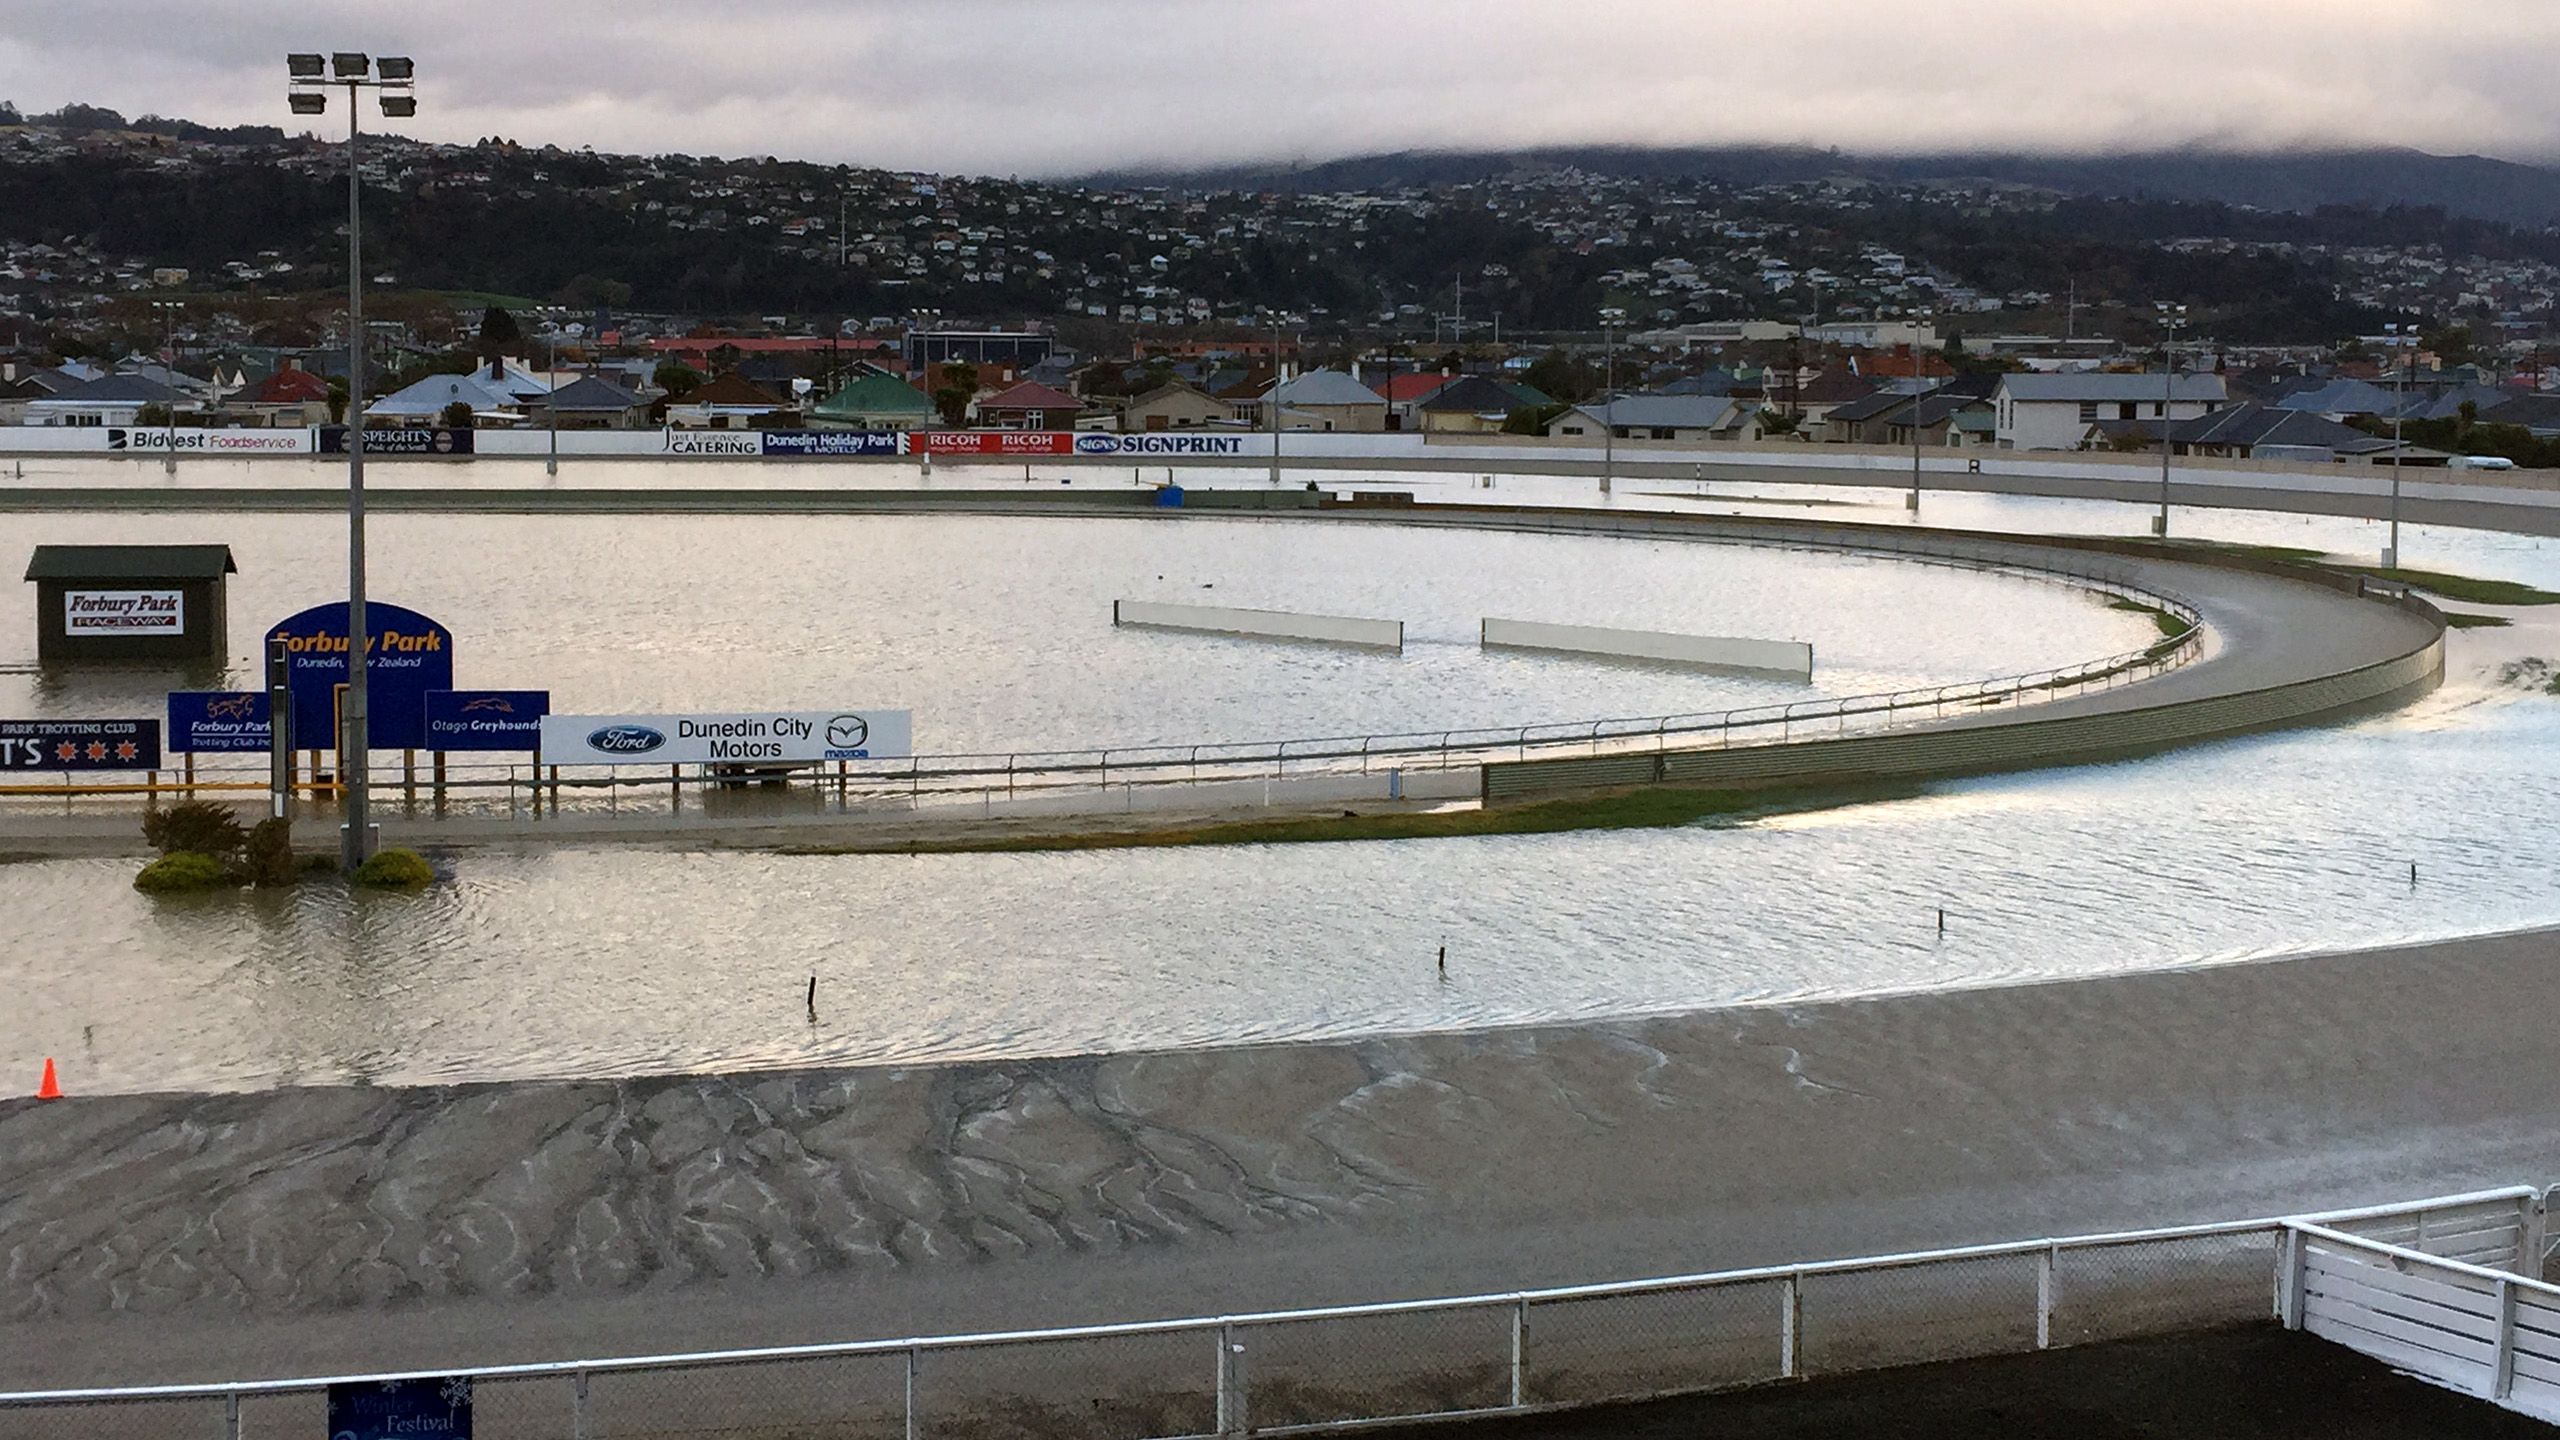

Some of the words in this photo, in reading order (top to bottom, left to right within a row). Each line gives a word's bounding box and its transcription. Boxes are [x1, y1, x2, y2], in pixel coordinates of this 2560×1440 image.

[133, 432, 204, 448] Bidvest
[209, 434, 297, 449] Foodservice
[361, 430, 432, 443] SPEIGHT'S
[766, 434, 817, 447] Dunedin
[820, 434, 864, 449] Holiday
[868, 434, 895, 447] Park
[930, 435, 981, 446] RICOH
[1002, 435, 1053, 446] RICOH
[672, 442, 757, 454] CATERING
[815, 446, 857, 454] MOTELS
[1078, 438, 1119, 450] SIGNS
[1122, 437, 1242, 453] SIGNPRINT
[69, 595, 137, 615] Forbury
[137, 595, 178, 611] Park
[77, 617, 171, 626] RACEWAY
[381, 630, 441, 652] Park
[296, 657, 345, 668] Dunedin,
[377, 657, 421, 668] Zealand
[2, 724, 34, 734] PARK
[37, 724, 101, 734] TROTTING
[104, 723, 137, 733] CLUB
[191, 721, 243, 735] Forbury
[432, 720, 468, 734] Otago
[679, 719, 766, 738] Dunedin
[772, 717, 813, 739] City
[602, 729, 650, 749] Ford
[710, 740, 782, 758] Motors
[386, 1406, 455, 1433] Festival
